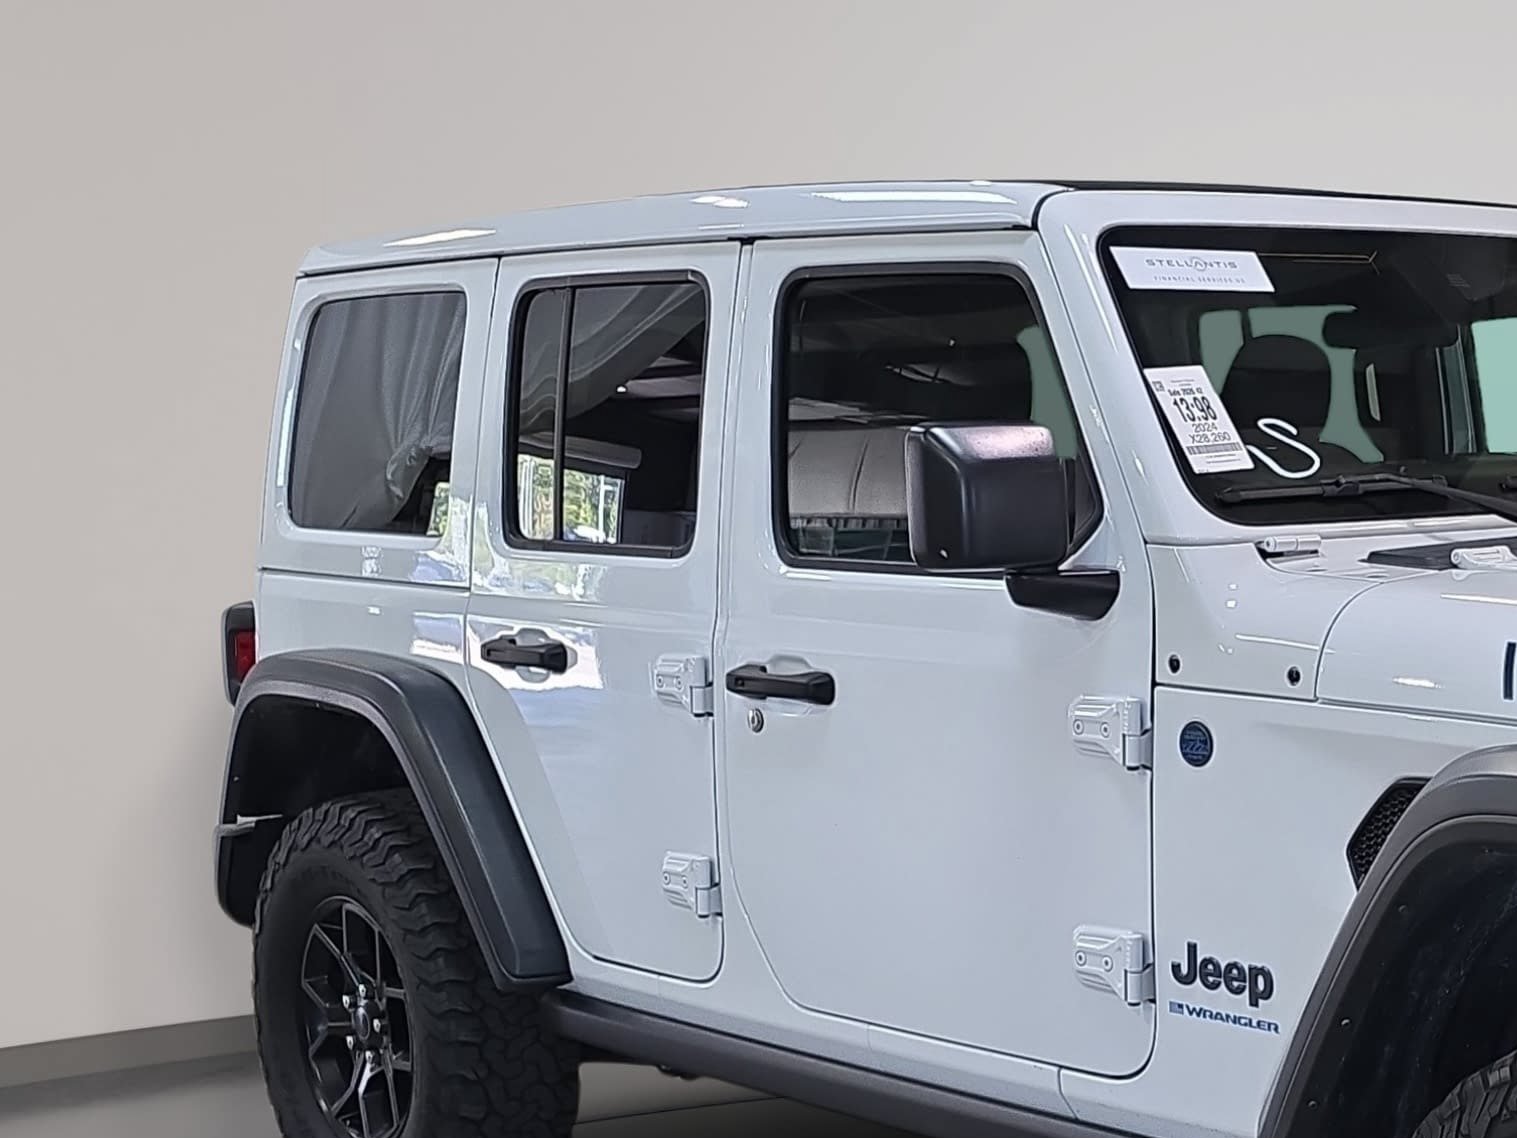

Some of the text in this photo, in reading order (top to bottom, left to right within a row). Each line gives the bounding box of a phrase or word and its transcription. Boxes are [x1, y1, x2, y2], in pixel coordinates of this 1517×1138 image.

[1145, 257, 1238, 271] STELLANTIS
[1172, 395, 1218, 423] 13:98
[1191, 422, 1219, 433] 2024
[1170, 940, 1274, 1009] Jeep
[1184, 1003, 1281, 1035] WRANGLER
